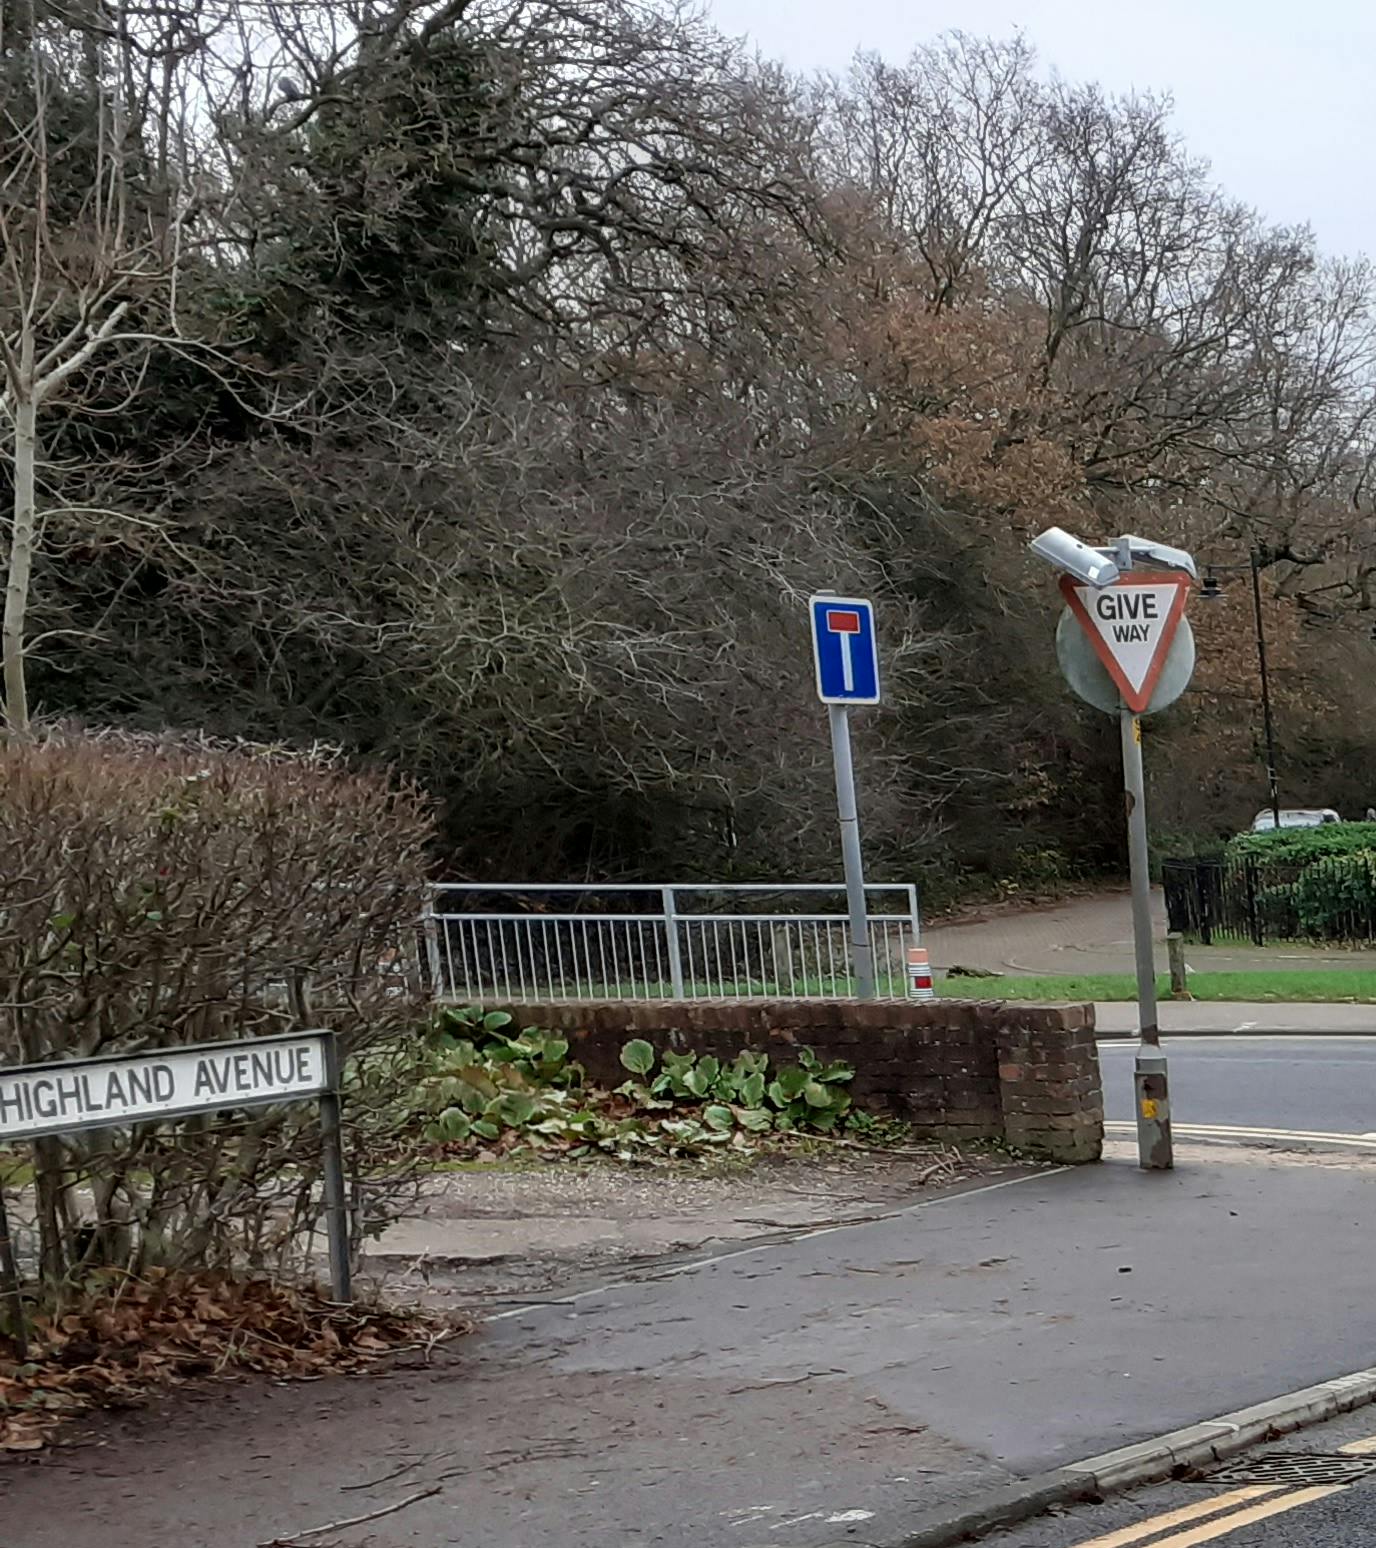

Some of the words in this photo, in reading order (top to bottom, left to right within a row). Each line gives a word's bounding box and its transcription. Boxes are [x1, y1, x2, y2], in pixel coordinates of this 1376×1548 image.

[1097, 594, 1158, 620] GIVE
[1113, 624, 1150, 642] WAY
[0, 1064, 175, 1124] HIGHLAND
[195, 1047, 312, 1096] AVENUE
